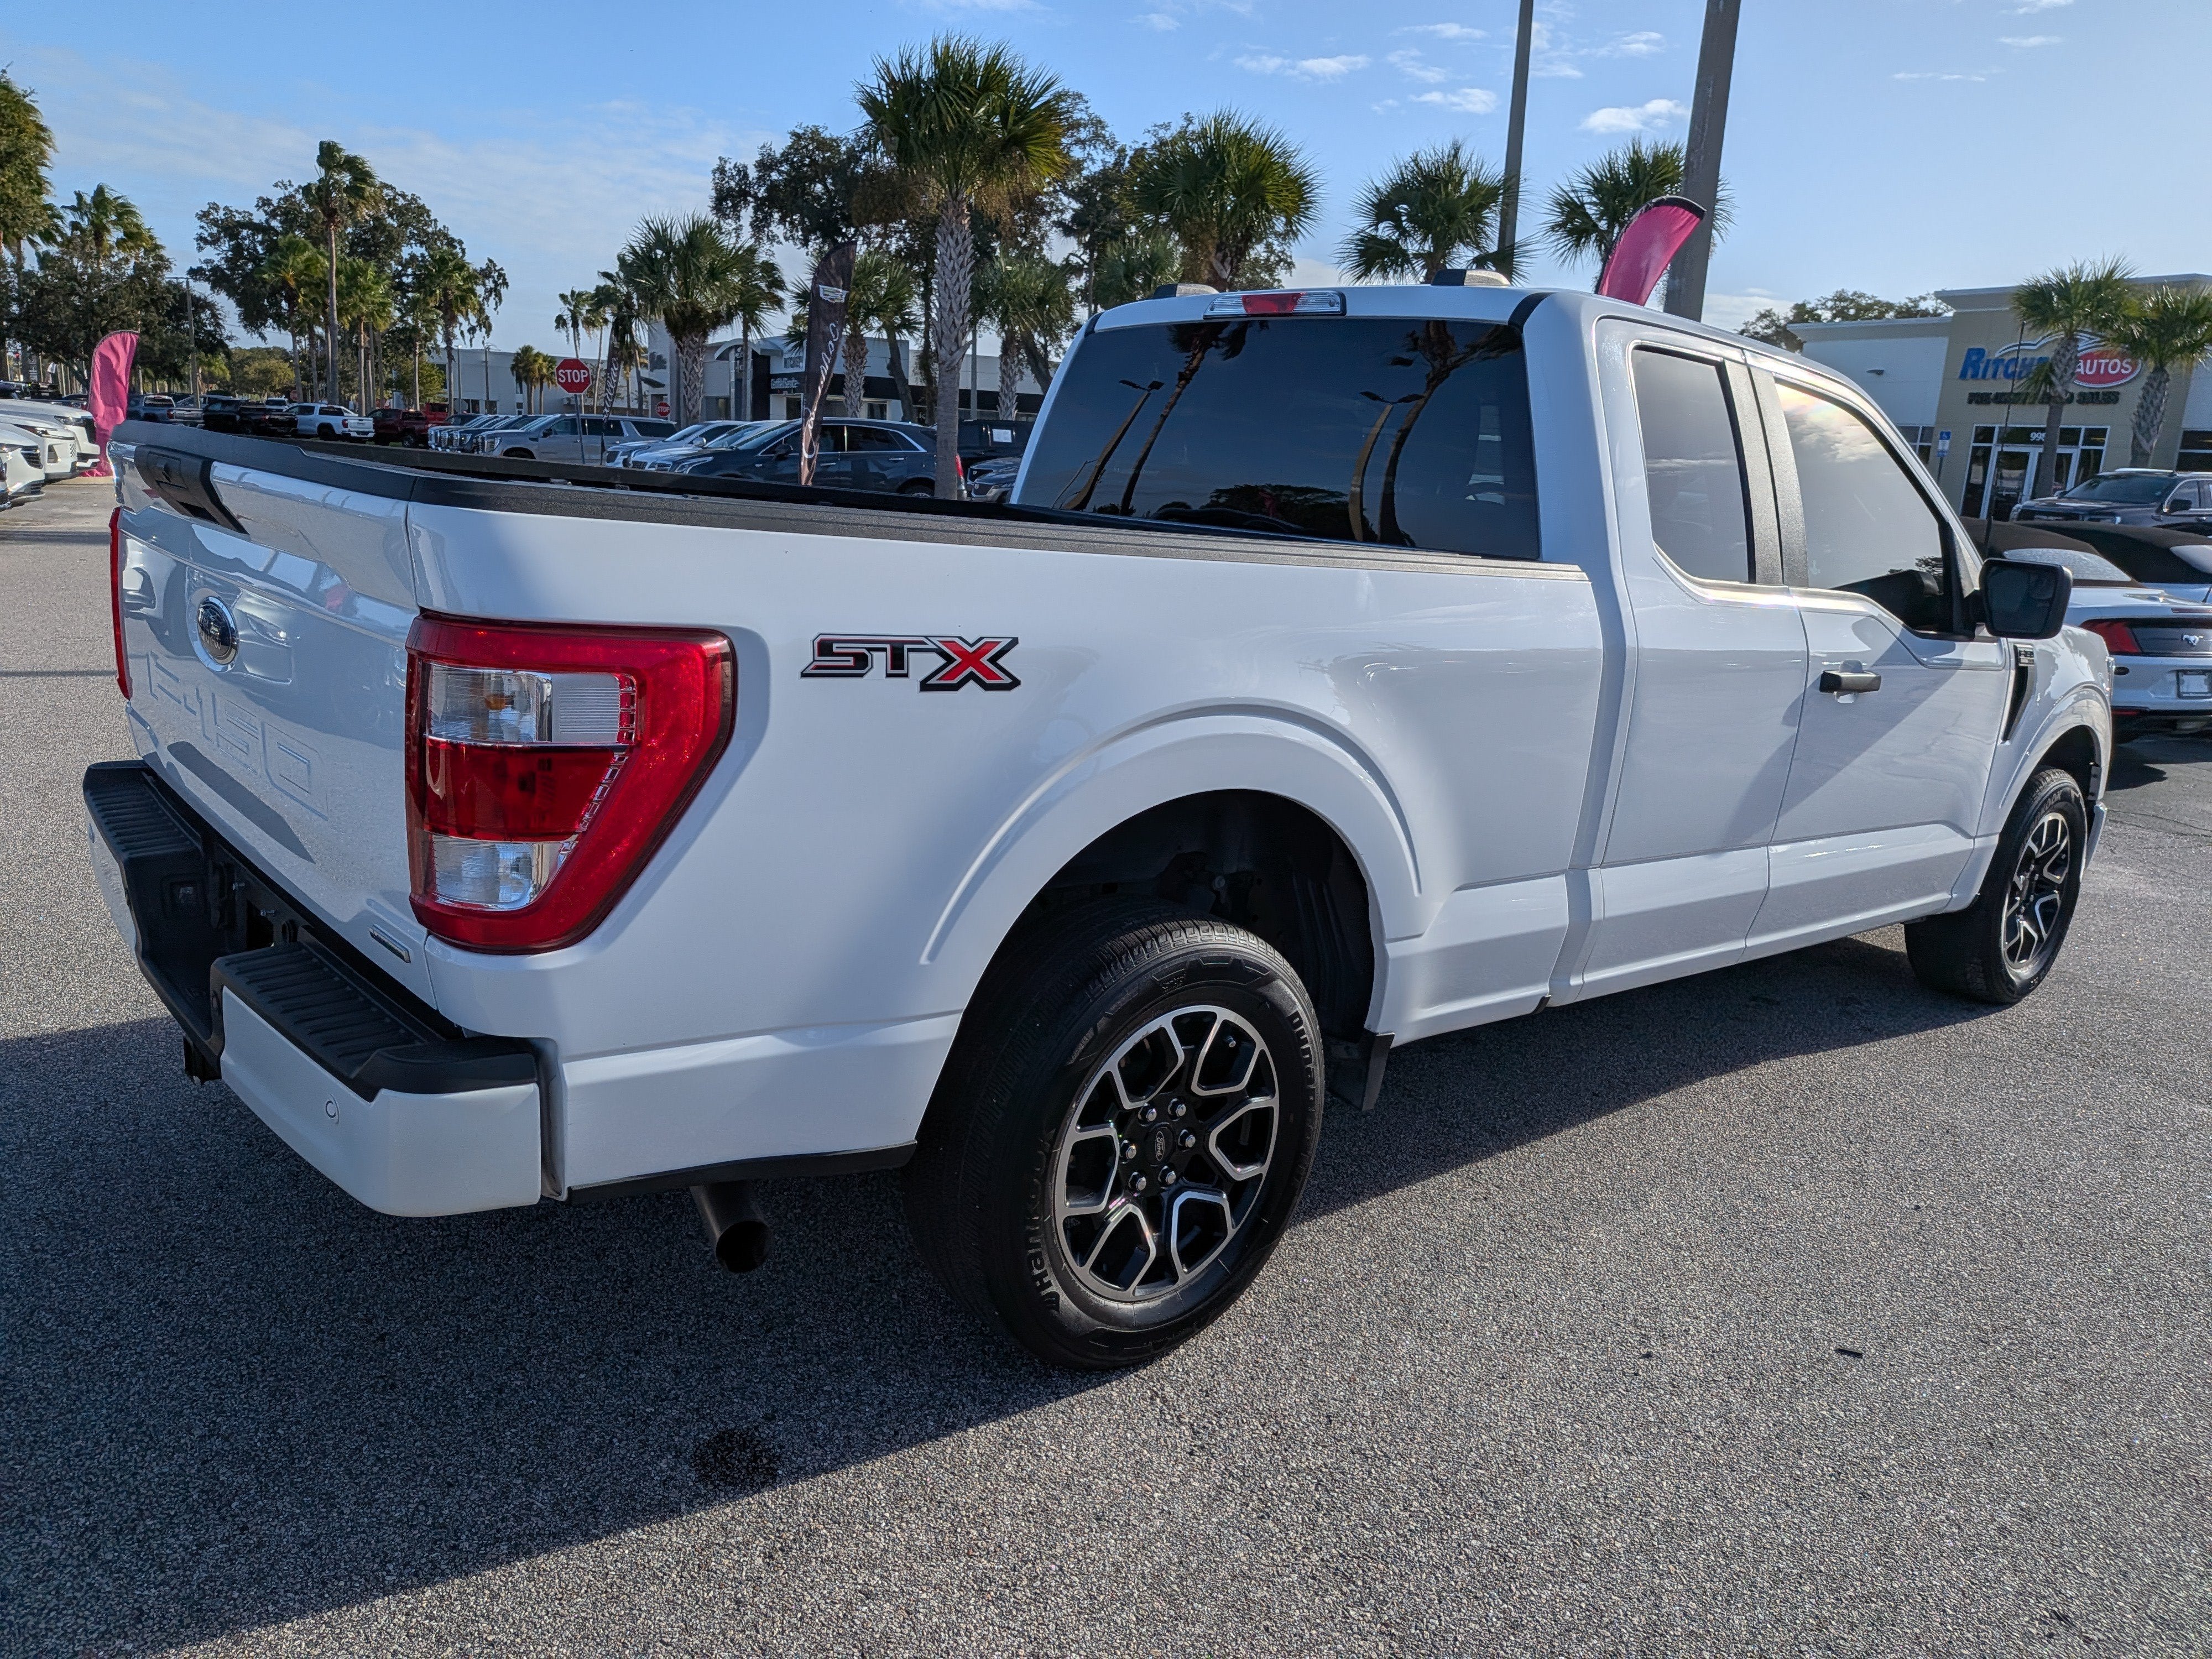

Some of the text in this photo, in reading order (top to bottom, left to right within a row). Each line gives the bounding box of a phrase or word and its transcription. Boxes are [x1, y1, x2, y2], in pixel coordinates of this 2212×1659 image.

[558, 369, 588, 383] STOP
[1959, 347, 2133, 380] RITCH AUTOS
[800, 633, 1021, 692] STX
[145, 650, 329, 821] F-150
